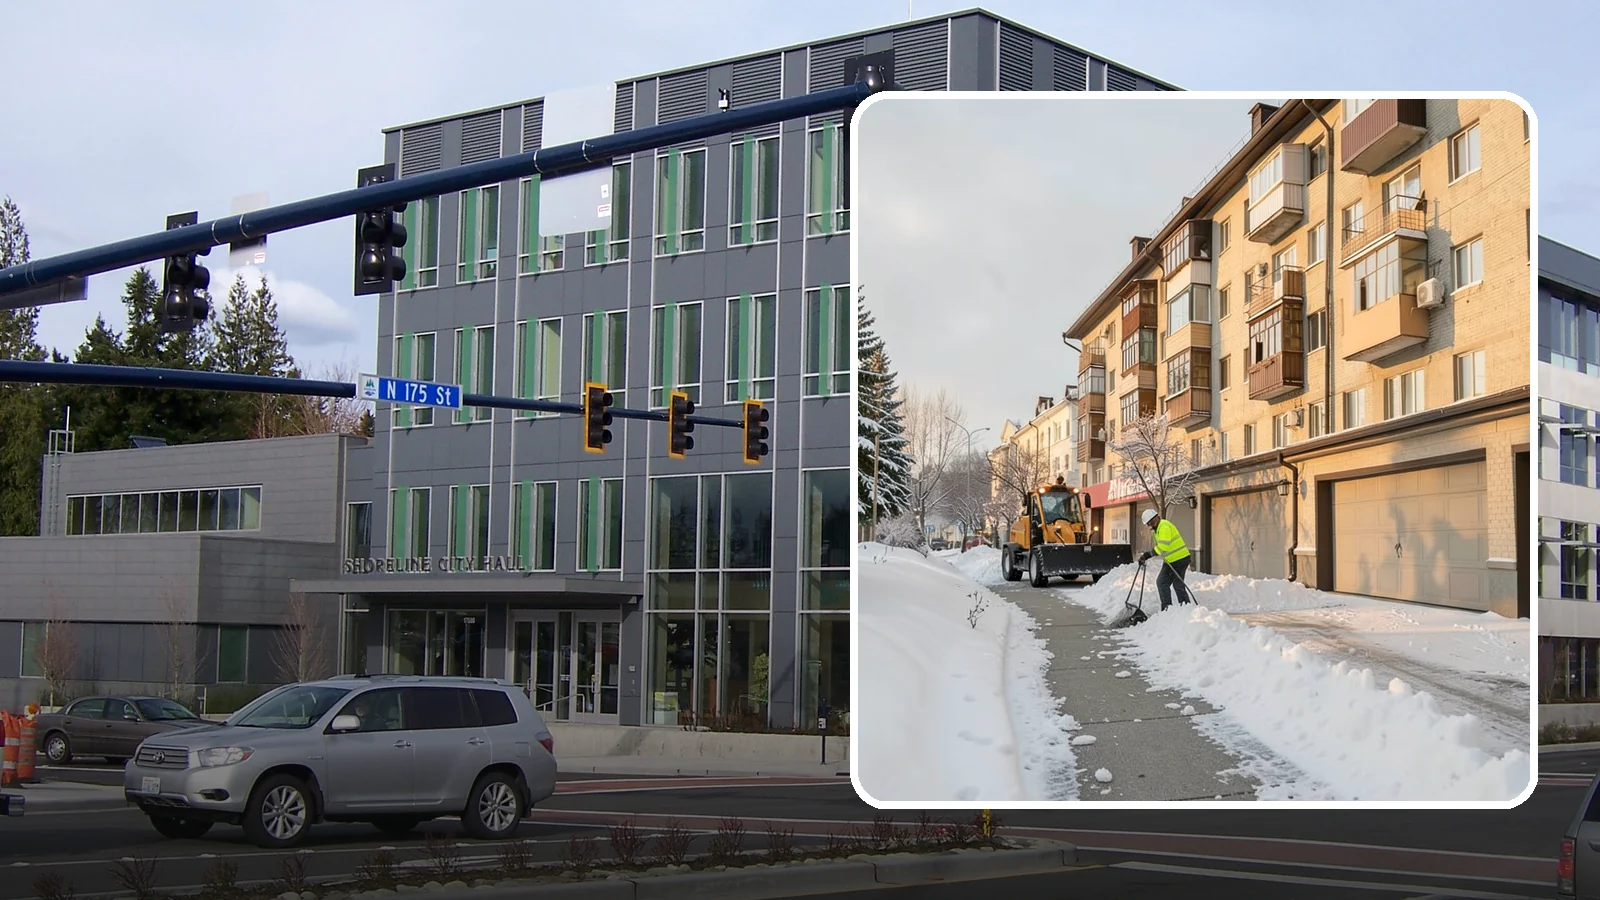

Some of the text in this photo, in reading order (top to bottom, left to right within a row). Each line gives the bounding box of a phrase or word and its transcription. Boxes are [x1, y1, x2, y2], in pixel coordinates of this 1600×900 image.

[387, 380, 452, 406] N 175 St
[343, 555, 526, 574] SHORELINE CITY HALL
